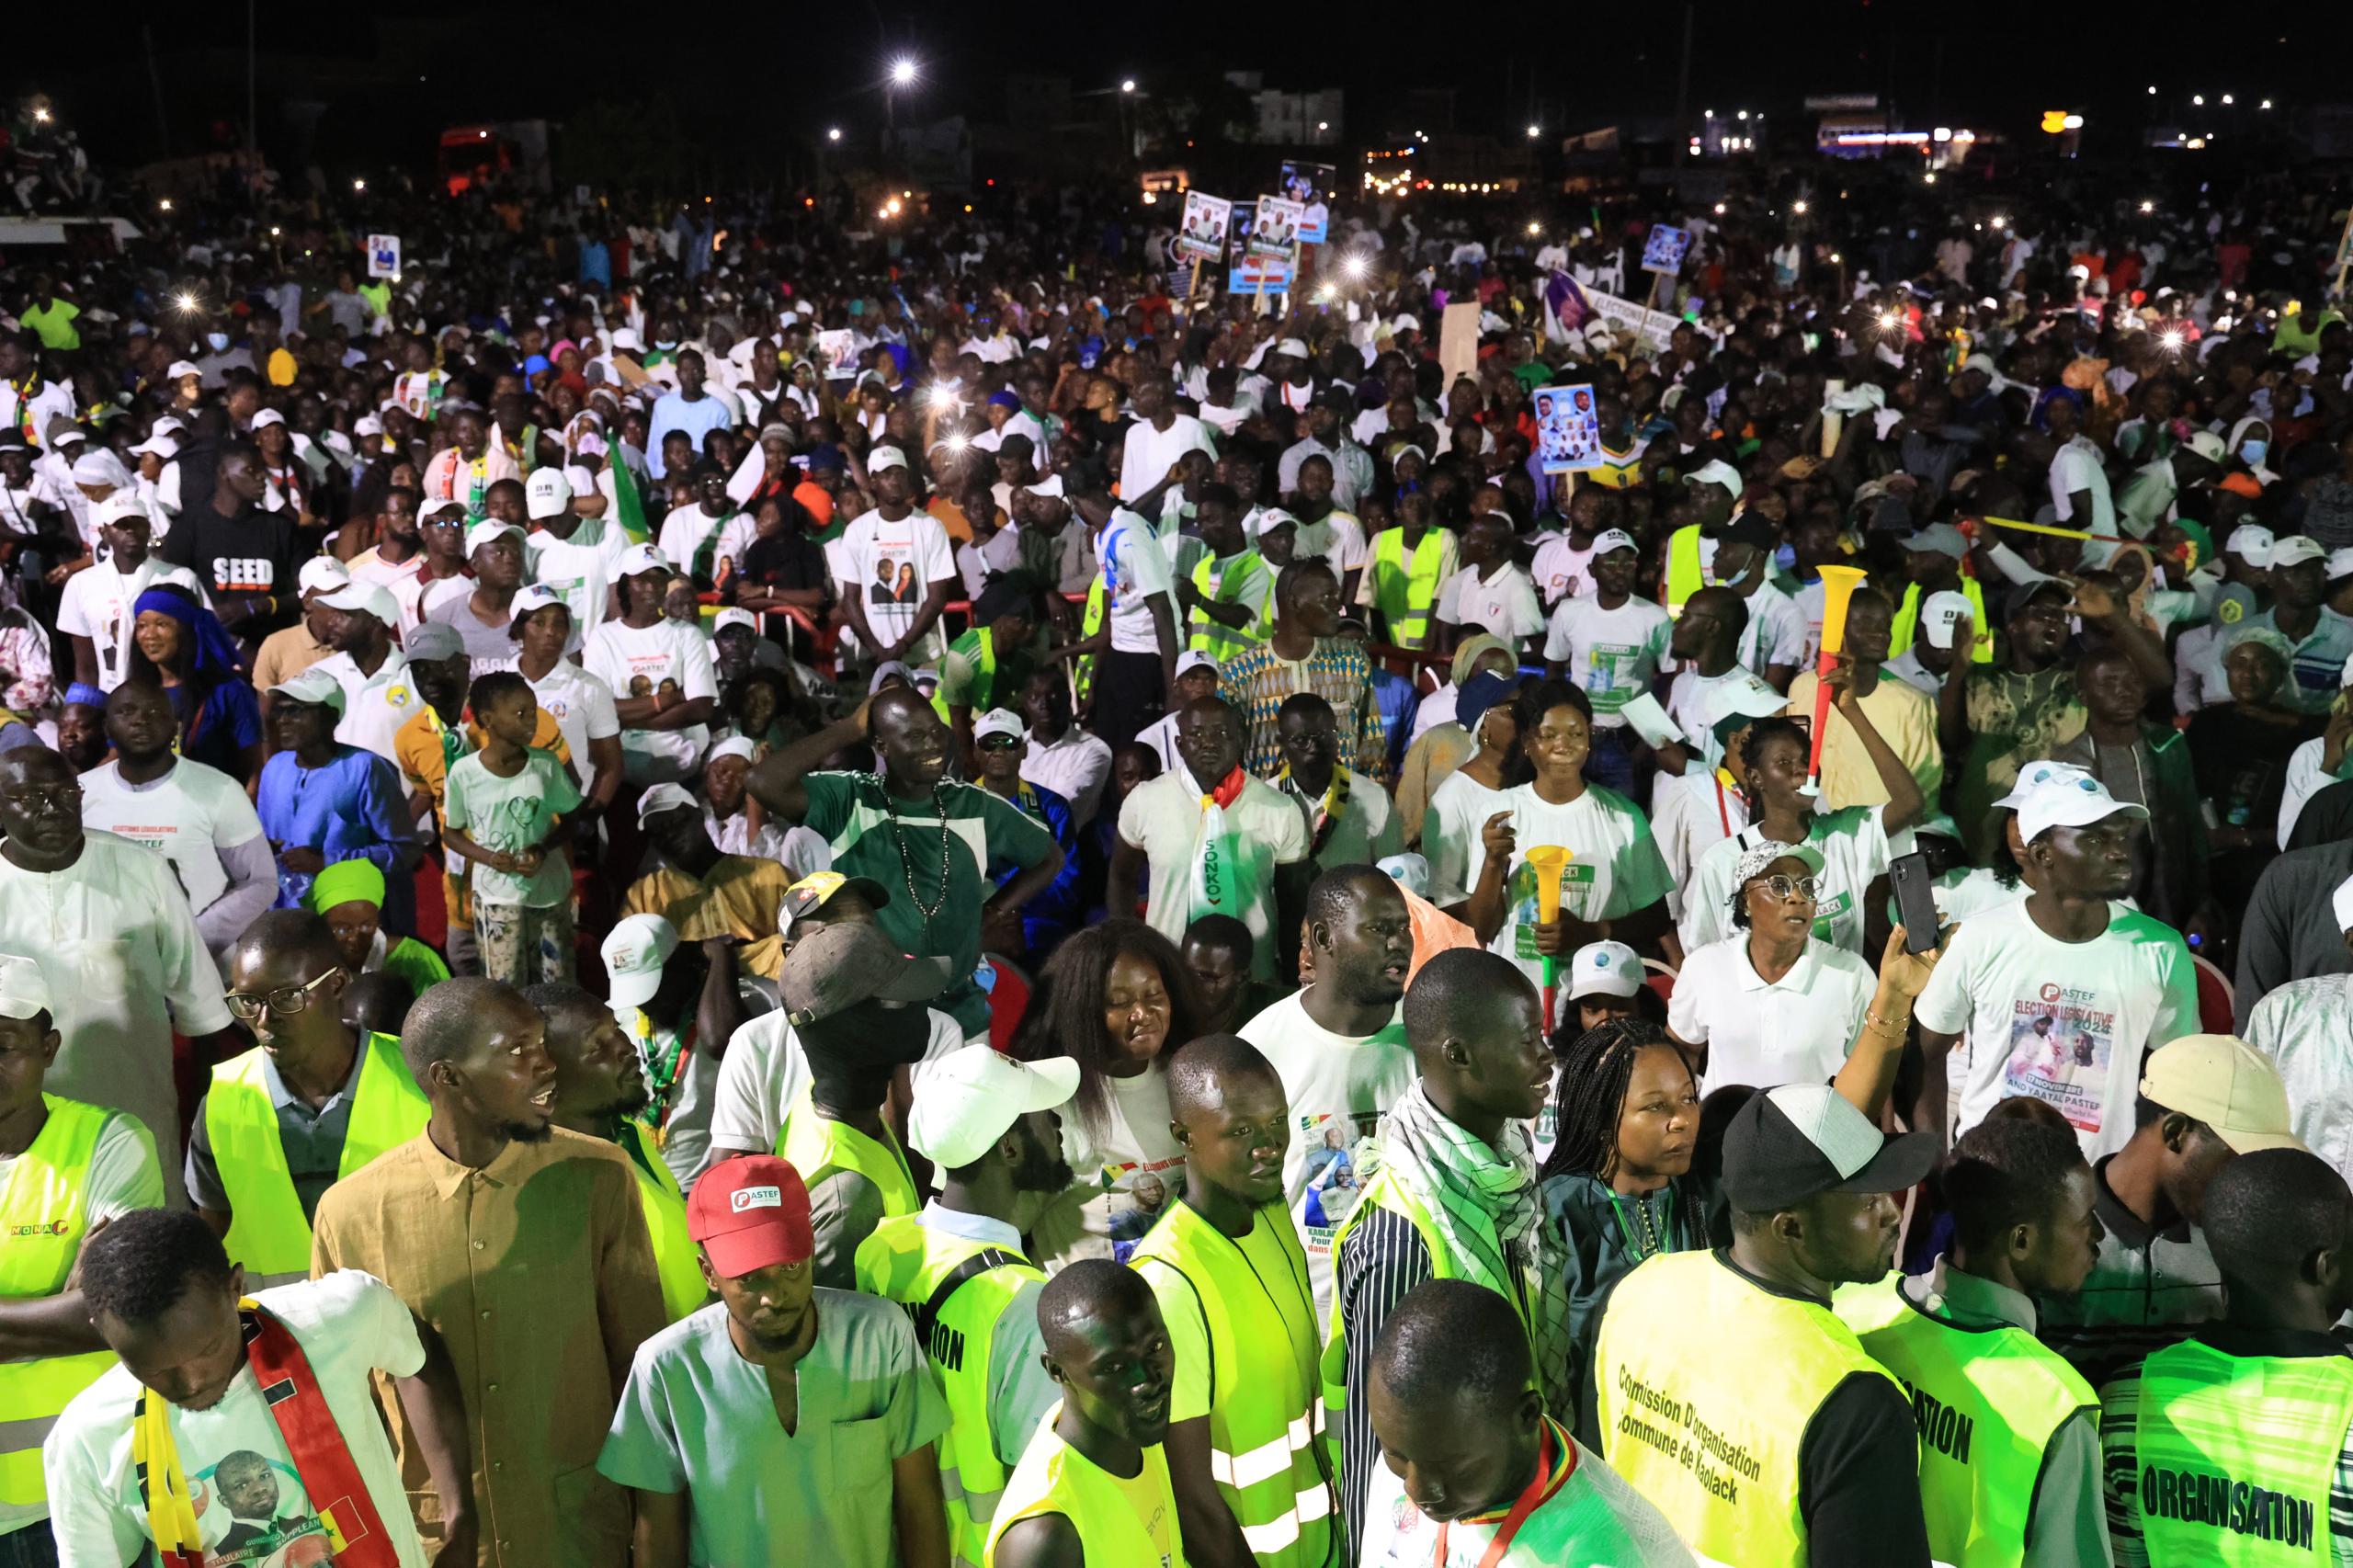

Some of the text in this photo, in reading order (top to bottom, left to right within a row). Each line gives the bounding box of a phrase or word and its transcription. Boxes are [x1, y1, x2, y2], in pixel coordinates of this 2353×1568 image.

[213, 557, 274, 586] SEED
[1204, 839, 1222, 896] SONKO
[2015, 1000, 2114, 1025] ELECTION LEGISLATIVE
[2073, 1018, 2112, 1035] 2024
[2007, 1079, 2028, 1092] AND
[2064, 1096, 2100, 1110] PASTEF
[734, 1191, 779, 1208] PASTEF
[1308, 1245, 1329, 1254] dans
[1312, 1237, 1331, 1246] Pour
[1680, 1440, 1694, 1470] de
[1695, 1449, 1738, 1506] Kaolack
[2143, 1464, 2313, 1552] ORGANISATION
[276, 1518, 320, 1548] SUPPLEAN
[213, 1548, 255, 1566] TITULAIRE
